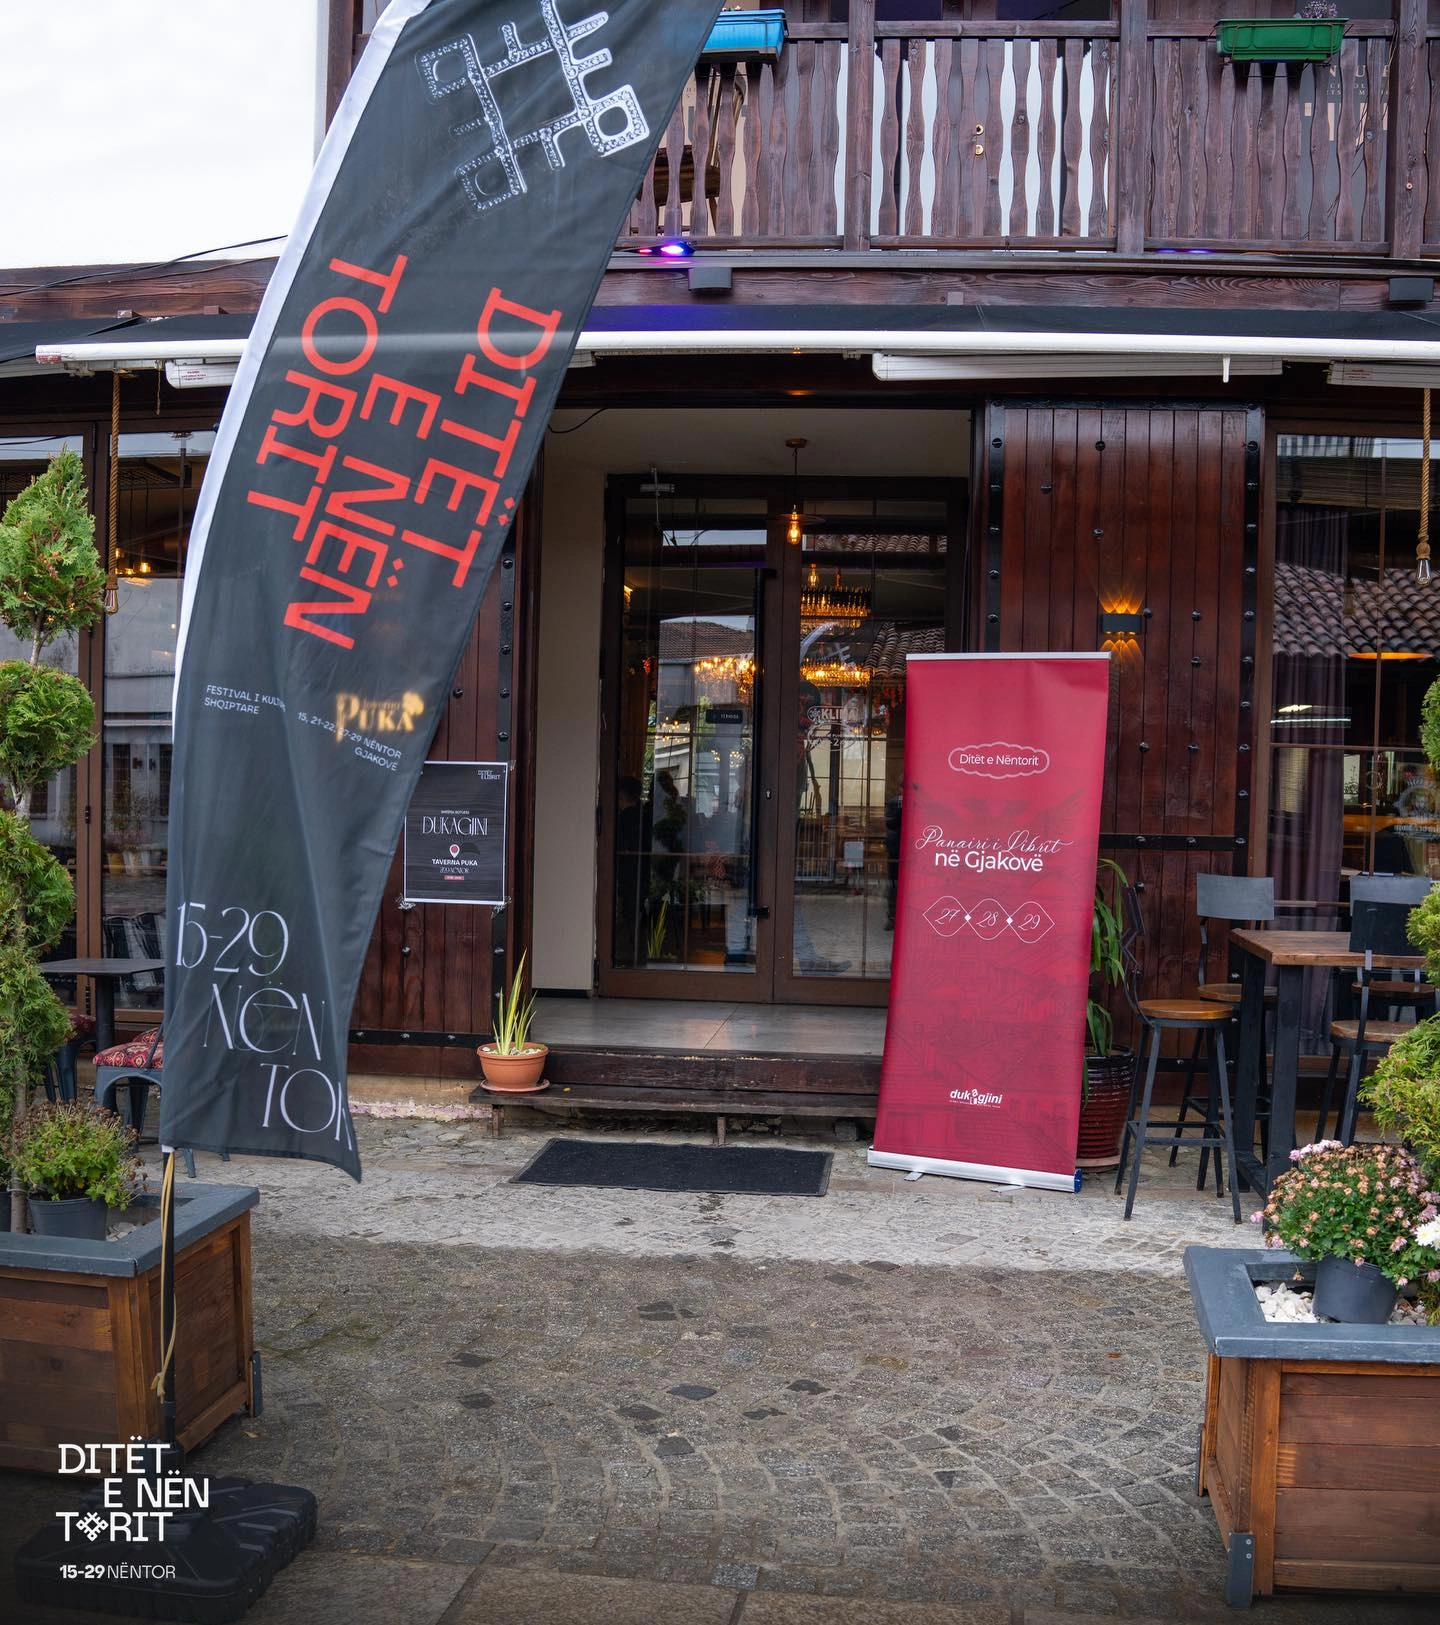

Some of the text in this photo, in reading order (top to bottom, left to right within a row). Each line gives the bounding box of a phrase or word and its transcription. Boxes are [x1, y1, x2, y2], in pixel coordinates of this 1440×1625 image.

[246, 254, 408, 541] TORIT
[402, 287, 562, 588] DITËT
[283, 373, 442, 650] E NËN
[206, 684, 252, 701] FESTIVAL
[254, 693, 260, 702] I
[204, 697, 260, 715] SHQIPTARE
[297, 712, 309, 722] 15,
[959, 753, 1039, 767] Ditët e Nëntorit
[422, 816, 488, 836] DUKAGJINI
[915, 825, 1074, 858] Panairi i Librit
[431, 858, 478, 867] TAVERNA PUKA
[935, 850, 1044, 873] në Gjakovë
[934, 908, 1041, 931] 27 28 29
[175, 901, 289, 977] 15-29
[949, 1088, 1003, 1105] dukagjini
